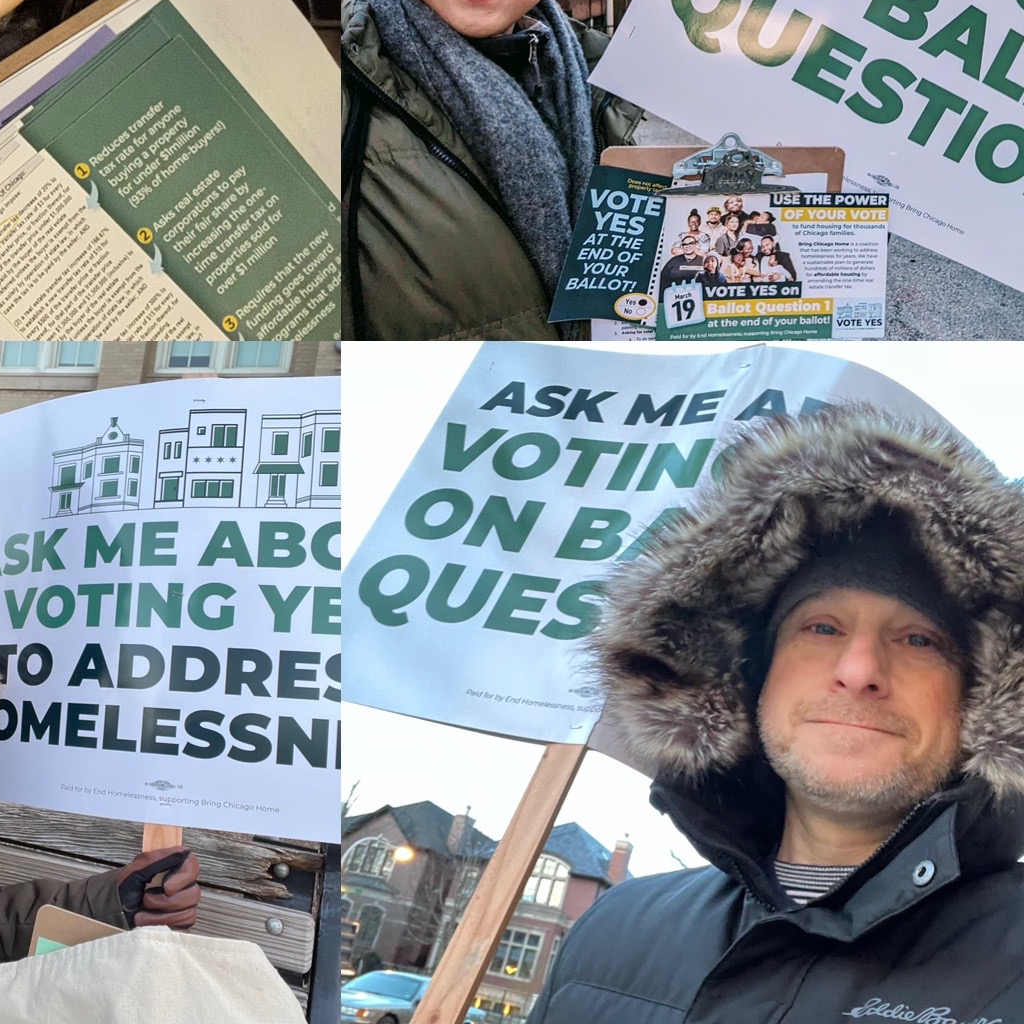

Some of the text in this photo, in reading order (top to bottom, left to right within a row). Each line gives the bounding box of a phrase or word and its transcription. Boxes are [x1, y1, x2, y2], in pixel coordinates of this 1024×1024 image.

[76, 100, 164, 176] 1 Reduces transfer
[98, 105, 182, 177] tax rate for anyone
[108, 117, 188, 187] buying a property
[118, 125, 201, 197] for under $1million
[128, 121, 226, 208] (93% of home-buyers!)
[152, 170, 221, 232] Asks real estate
[590, 189, 664, 216] VOTE
[773, 195, 886, 205] USE THE POWER
[595, 211, 646, 235] YES
[784, 210, 886, 219] OF YOUR VOTE
[583, 234, 644, 250] AT THE
[577, 248, 642, 263] END OF
[583, 263, 629, 276] YOUR
[565, 278, 637, 292] BALLOT!
[705, 285, 799, 297] VOTE YES on
[672, 299, 695, 322] 19
[707, 300, 830, 314] Ballot Question 1
[708, 316, 830, 329] at the end of your ballot!
[480, 381, 727, 426] ASK ME
[404, 488, 546, 553] ON
[84, 520, 179, 568] ME
[4, 582, 237, 630] VOTING
[466, 688, 482, 697] Paid
[496, 694, 504, 702] by
[505, 696, 520, 704] End
[108, 790, 157, 801] Homelessness,
[159, 796, 199, 806] supporting
[201, 799, 221, 808] Bring
[223, 802, 254, 811] Chicago
[256, 805, 280, 813] Home
[842, 998, 915, 1021] Eddie
